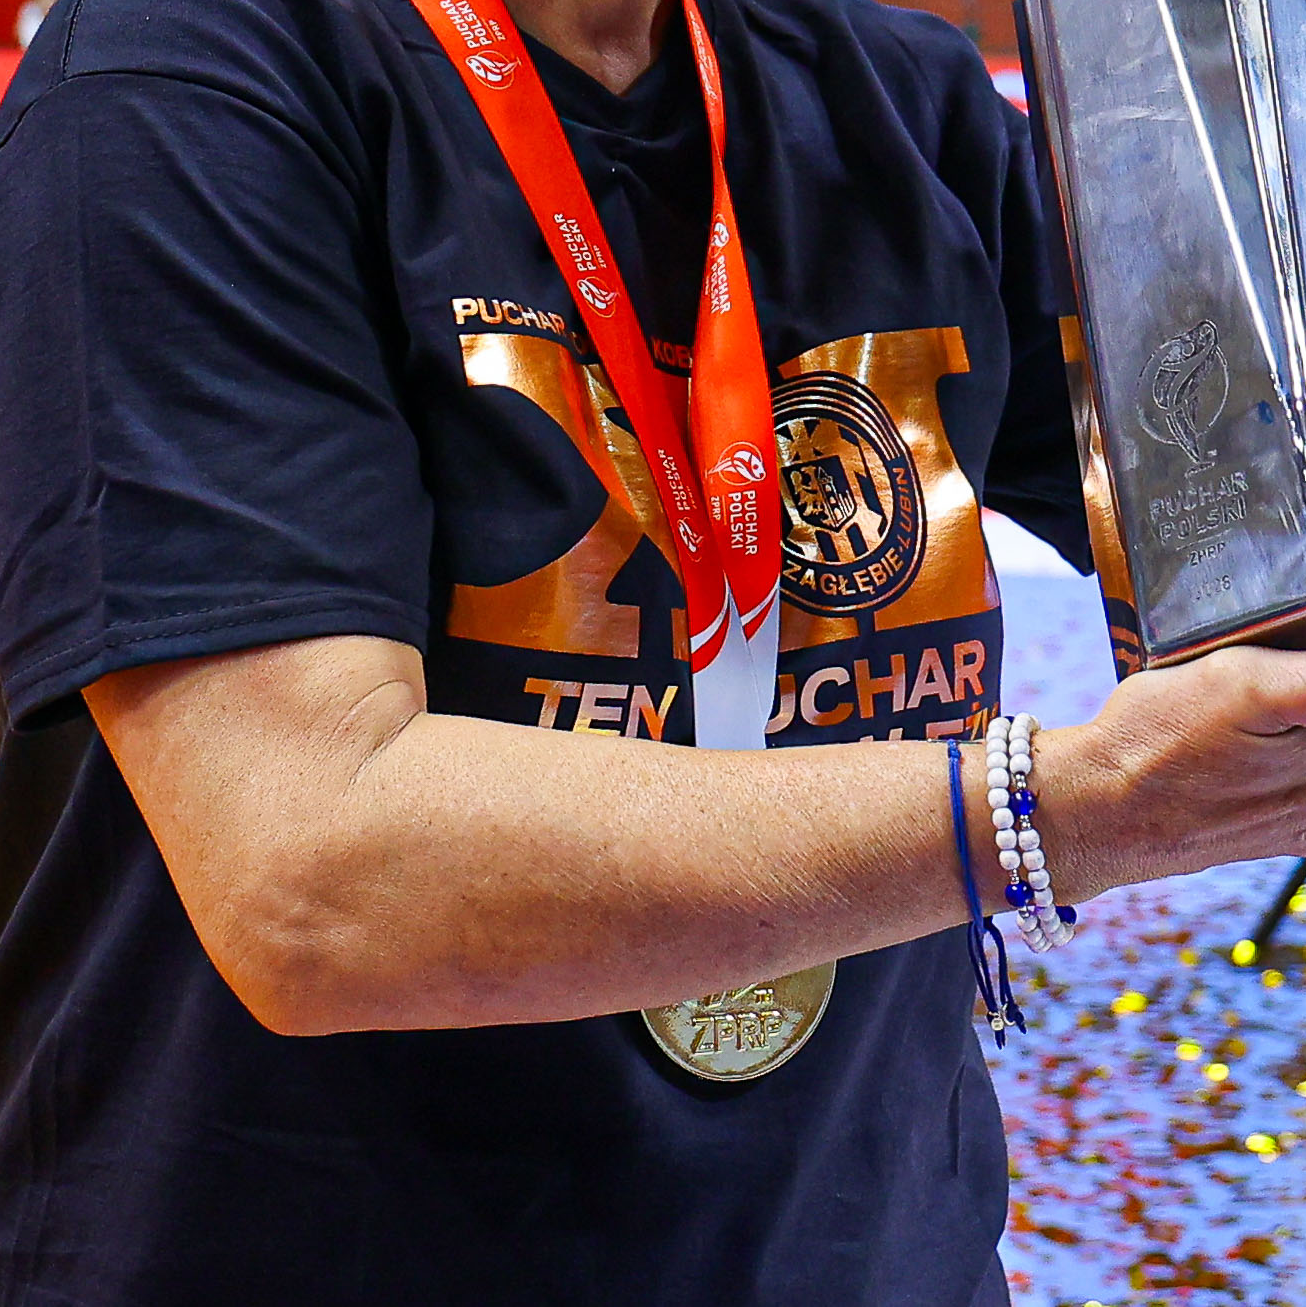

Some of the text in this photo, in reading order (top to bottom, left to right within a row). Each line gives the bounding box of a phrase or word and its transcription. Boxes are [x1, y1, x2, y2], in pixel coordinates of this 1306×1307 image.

[455, 0, 492, 45] POLSKI
[554, 213, 587, 271] PUCHAR
[566, 219, 596, 270] POLSKI
[717, 255, 731, 315] PUCHAR
[450, 297, 565, 335] PUCHAR
[710, 496, 722, 522] ZPRP
[728, 492, 744, 549] POLSKI
[743, 490, 758, 555] PUCHAR
[1159, 495, 1247, 545] POLSKI
[524, 677, 679, 742] TEN
[764, 639, 986, 734] UCHAR
[691, 1009, 784, 1055] ZPRP
